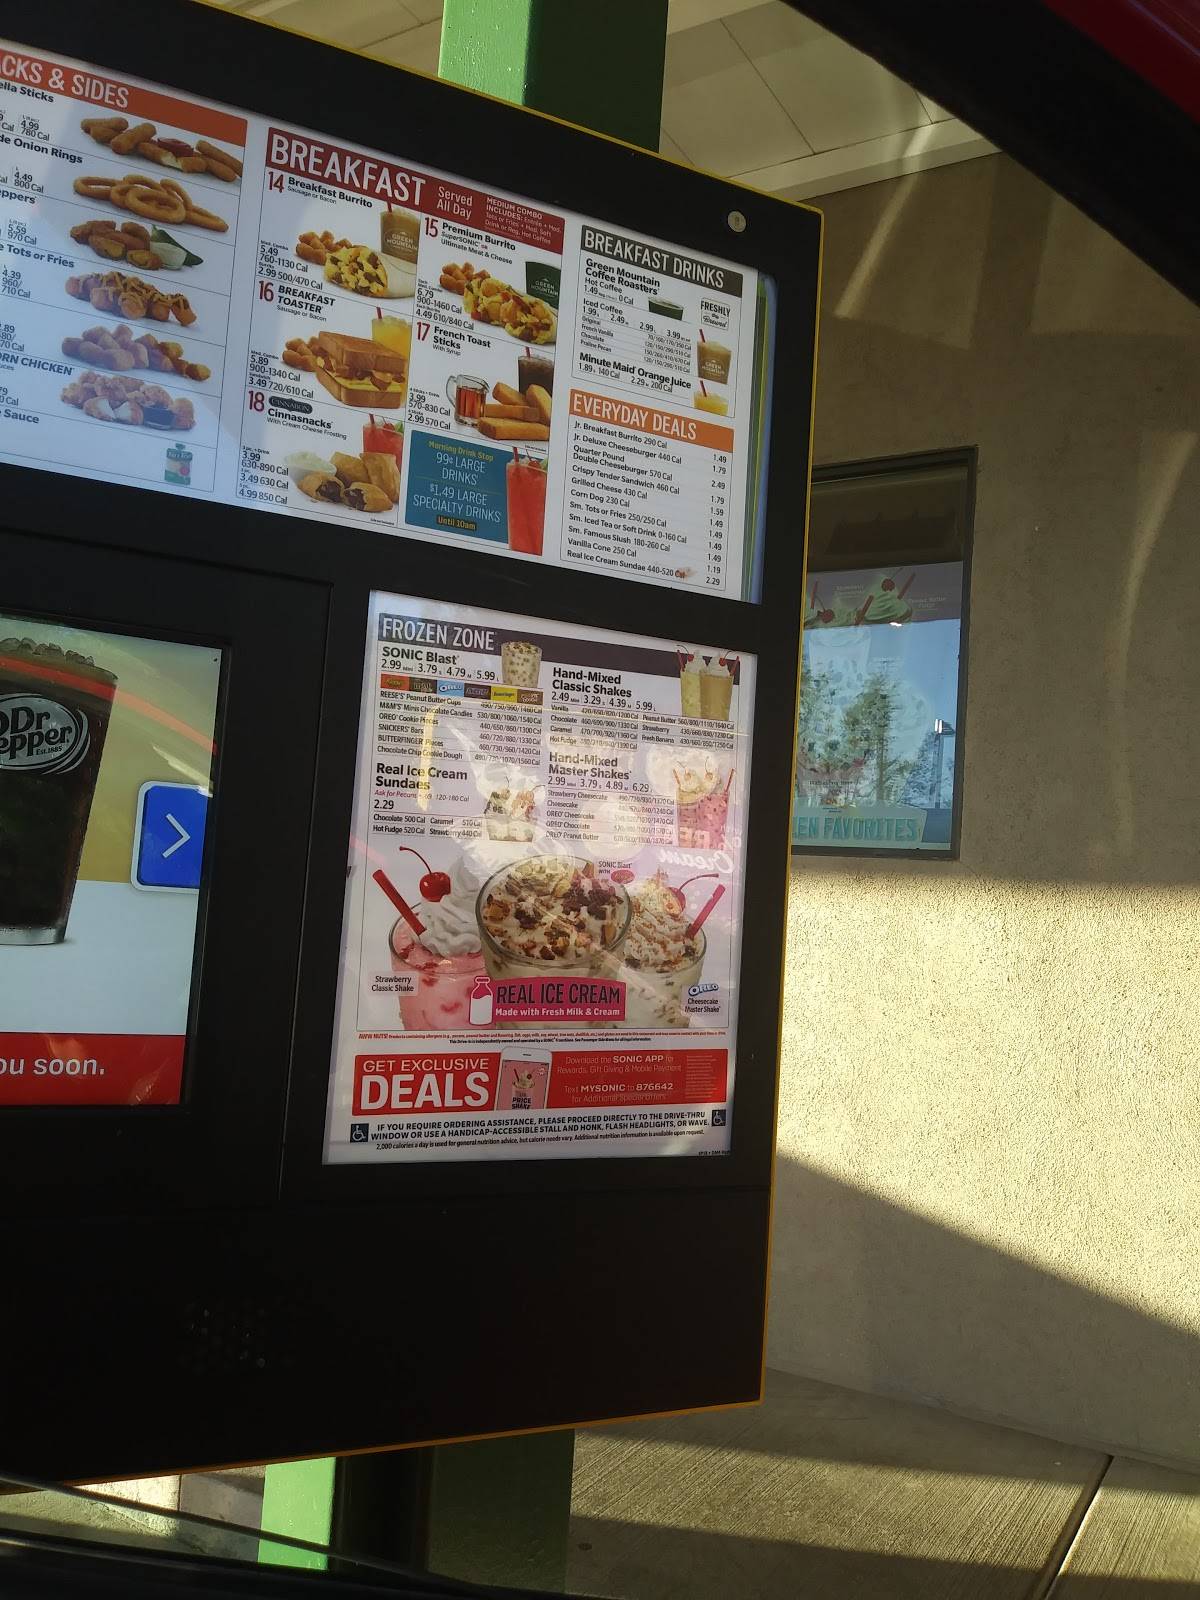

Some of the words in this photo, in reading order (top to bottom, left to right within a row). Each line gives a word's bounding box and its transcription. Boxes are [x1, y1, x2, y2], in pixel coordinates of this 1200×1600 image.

[0, 55, 43, 84] CKS
[49, 69, 65, 91] &
[72, 74, 129, 108] SIDES
[20, 86, 54, 103] Sticks
[14, 138, 48, 154] Onion
[51, 148, 83, 164] Rings
[14, 171, 33, 182] 4.49
[271, 133, 426, 206] BREAKFAST
[14, 178, 30, 188] 800
[31, 184, 44, 193] Cal
[268, 171, 284, 193] 14
[289, 177, 336, 198] Breakfast
[339, 191, 372, 208] Burrito
[439, 186, 472, 206] Served
[437, 199, 449, 212] All
[454, 203, 471, 220] Day
[487, 197, 515, 210] MEDIUM
[517, 206, 543, 220] COMBO
[425, 217, 438, 238] 15
[443, 222, 482, 240] Premium
[485, 233, 516, 251] Burrito
[8, 245, 31, 259] Tots
[47, 254, 75, 268] Fries
[585, 230, 669, 271] BREAKFAST
[674, 258, 724, 288] DRINKS
[258, 266, 276, 278] 2.99
[278, 273, 309, 287] 500/470
[310, 280, 322, 290] Cal
[586, 258, 614, 274] Green
[617, 268, 660, 287] Mountain
[586, 268, 616, 284] Coffee
[618, 277, 657, 295] Roasters
[258, 280, 274, 303] 16
[278, 285, 335, 307] BREAKFAST
[585, 277, 598, 286] Hot
[600, 282, 622, 294] Coffee
[278, 295, 321, 314] TOASTER
[583, 299, 599, 310] Iced
[600, 304, 623, 315] Coffee
[701, 301, 731, 317] FRESHLY
[583, 306, 597, 316] 1.99
[610, 314, 625, 325] 2.49
[640, 322, 654, 332] 2.99
[667, 330, 681, 340] 3.99
[417, 321, 430, 341] 17
[434, 326, 465, 341] French
[467, 335, 491, 348] Toast
[433, 336, 461, 350] Sticks
[579, 352, 611, 368] Minute
[638, 367, 670, 384] Orange
[670, 377, 691, 389] Juice
[248, 390, 265, 413] 18
[4, 409, 39, 424] Sauce
[268, 409, 332, 429] Cinnasnacks
[408, 414, 424, 424] 2.99
[425, 418, 438, 427] 570
[439, 421, 450, 429] Cal
[573, 394, 648, 428] EVERYDAY
[653, 414, 697, 440] DEALS
[574, 421, 582, 430] Jr.
[584, 423, 617, 438] Breakfast
[618, 432, 642, 443] Burrito
[644, 437, 656, 445] 290
[657, 440, 667, 449] Cal
[713, 454, 727, 463] 1.49
[573, 445, 601, 457] Quarter
[602, 451, 624, 462] Pound
[455, 456, 485, 473] LARGE
[573, 453, 598, 464] Double
[600, 458, 648, 476] Cheeseburger
[650, 470, 661, 478] 570
[663, 473, 672, 481] Cal
[712, 481, 725, 490] 2.49
[442, 468, 476, 486] DRINKS
[572, 465, 595, 478] Crispy
[597, 470, 620, 482] Tender
[621, 475, 654, 489] Sandwich
[656, 483, 669, 491] 460
[670, 486, 679, 494] Cal
[711, 496, 724, 504] 1.79
[430, 484, 454, 497] $1.49
[457, 489, 487, 505] LARGE
[413, 496, 464, 514] SPECIALTY
[466, 507, 499, 523] DRINKS
[571, 490, 588, 499] Corn
[590, 493, 604, 503] Dog
[606, 497, 618, 505] 230
[620, 499, 630, 507] Cal
[710, 519, 723, 527] 1.49
[438, 516, 455, 527] Until
[457, 520, 476, 529] 10am
[568, 550, 582, 560] Real
[584, 553, 595, 562] Ice
[596, 556, 618, 566] Cream
[620, 560, 645, 571] Sundae
[647, 564, 673, 577] 440-520
[675, 569, 685, 578] Cal
[706, 577, 720, 585] 2.29
[382, 618, 447, 645] FROZEN
[453, 627, 494, 650] ZONE
[383, 646, 423, 661] SONIC
[426, 652, 457, 665] Blast
[381, 659, 401, 669] 2.99
[418, 663, 437, 674] 3.79
[446, 667, 465, 678] 4.79
[477, 670, 495, 680] 5.99
[553, 667, 621, 685] Hand-Mixed
[553, 680, 591, 693] Classic
[593, 686, 632, 698] Shakes
[552, 692, 569, 702] 2.49
[584, 695, 601, 705] 3.29
[609, 698, 626, 708] 4.39
[636, 702, 653, 711] 5.99
[11, 707, 50, 735] Dr
[377, 763, 403, 775] Real
[407, 767, 424, 777] Ice
[428, 768, 467, 780] Cream
[376, 776, 430, 789] Sundaes
[374, 799, 394, 809] 2.29
[824, 817, 917, 840] FAVORITES
[375, 976, 411, 984] Strawberry
[688, 984, 719, 996] OREO
[497, 986, 536, 1003] REAL
[541, 984, 564, 1003] ICE
[569, 984, 620, 1004] CREAM
[496, 1008, 518, 1016] Made
[520, 1008, 539, 1016] with
[542, 1008, 564, 1016] Fresh
[567, 1008, 584, 1016] Milk
[586, 1008, 592, 1016] &
[594, 1008, 620, 1016] Cream
[33, 1058, 104, 1075] soon.
[363, 1060, 395, 1072] GET
[401, 1059, 488, 1071] EXCLUSIVE
[361, 1072, 489, 1110] DEALS
[581, 1084, 625, 1092] MYSONIC
[636, 1083, 673, 1091] 876642
[407, 1122, 441, 1130] REQUIRE
[444, 1120, 485, 1128] ORDERING
[487, 1118, 536, 1127] ASSISTANCE,
[568, 1115, 601, 1123] PROCEED
[604, 1114, 637, 1122] DIRECTLY
